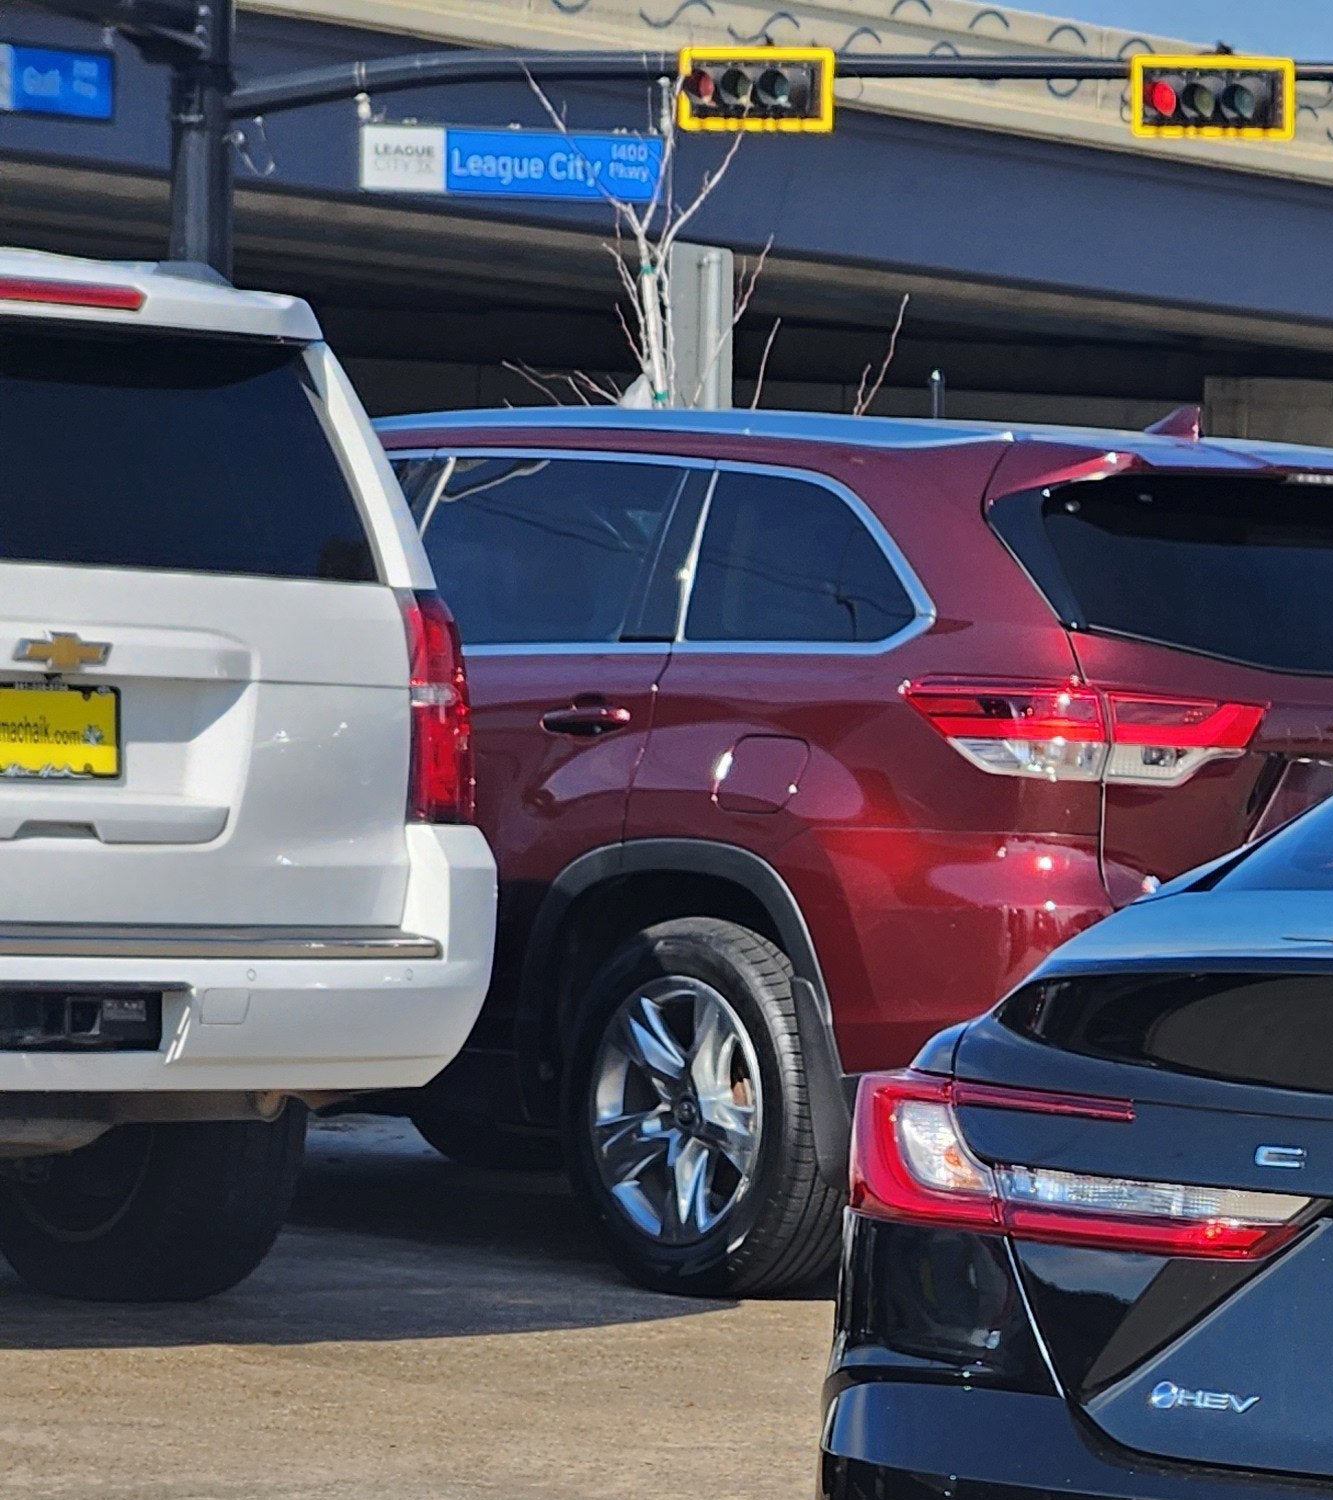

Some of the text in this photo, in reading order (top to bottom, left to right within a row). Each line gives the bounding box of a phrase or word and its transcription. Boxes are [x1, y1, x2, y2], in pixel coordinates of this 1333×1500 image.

[374, 142, 435, 158] LEAGUE
[611, 143, 648, 161] 1400
[451, 147, 601, 187] League City
[1177, 1387, 1260, 1414] HEV
